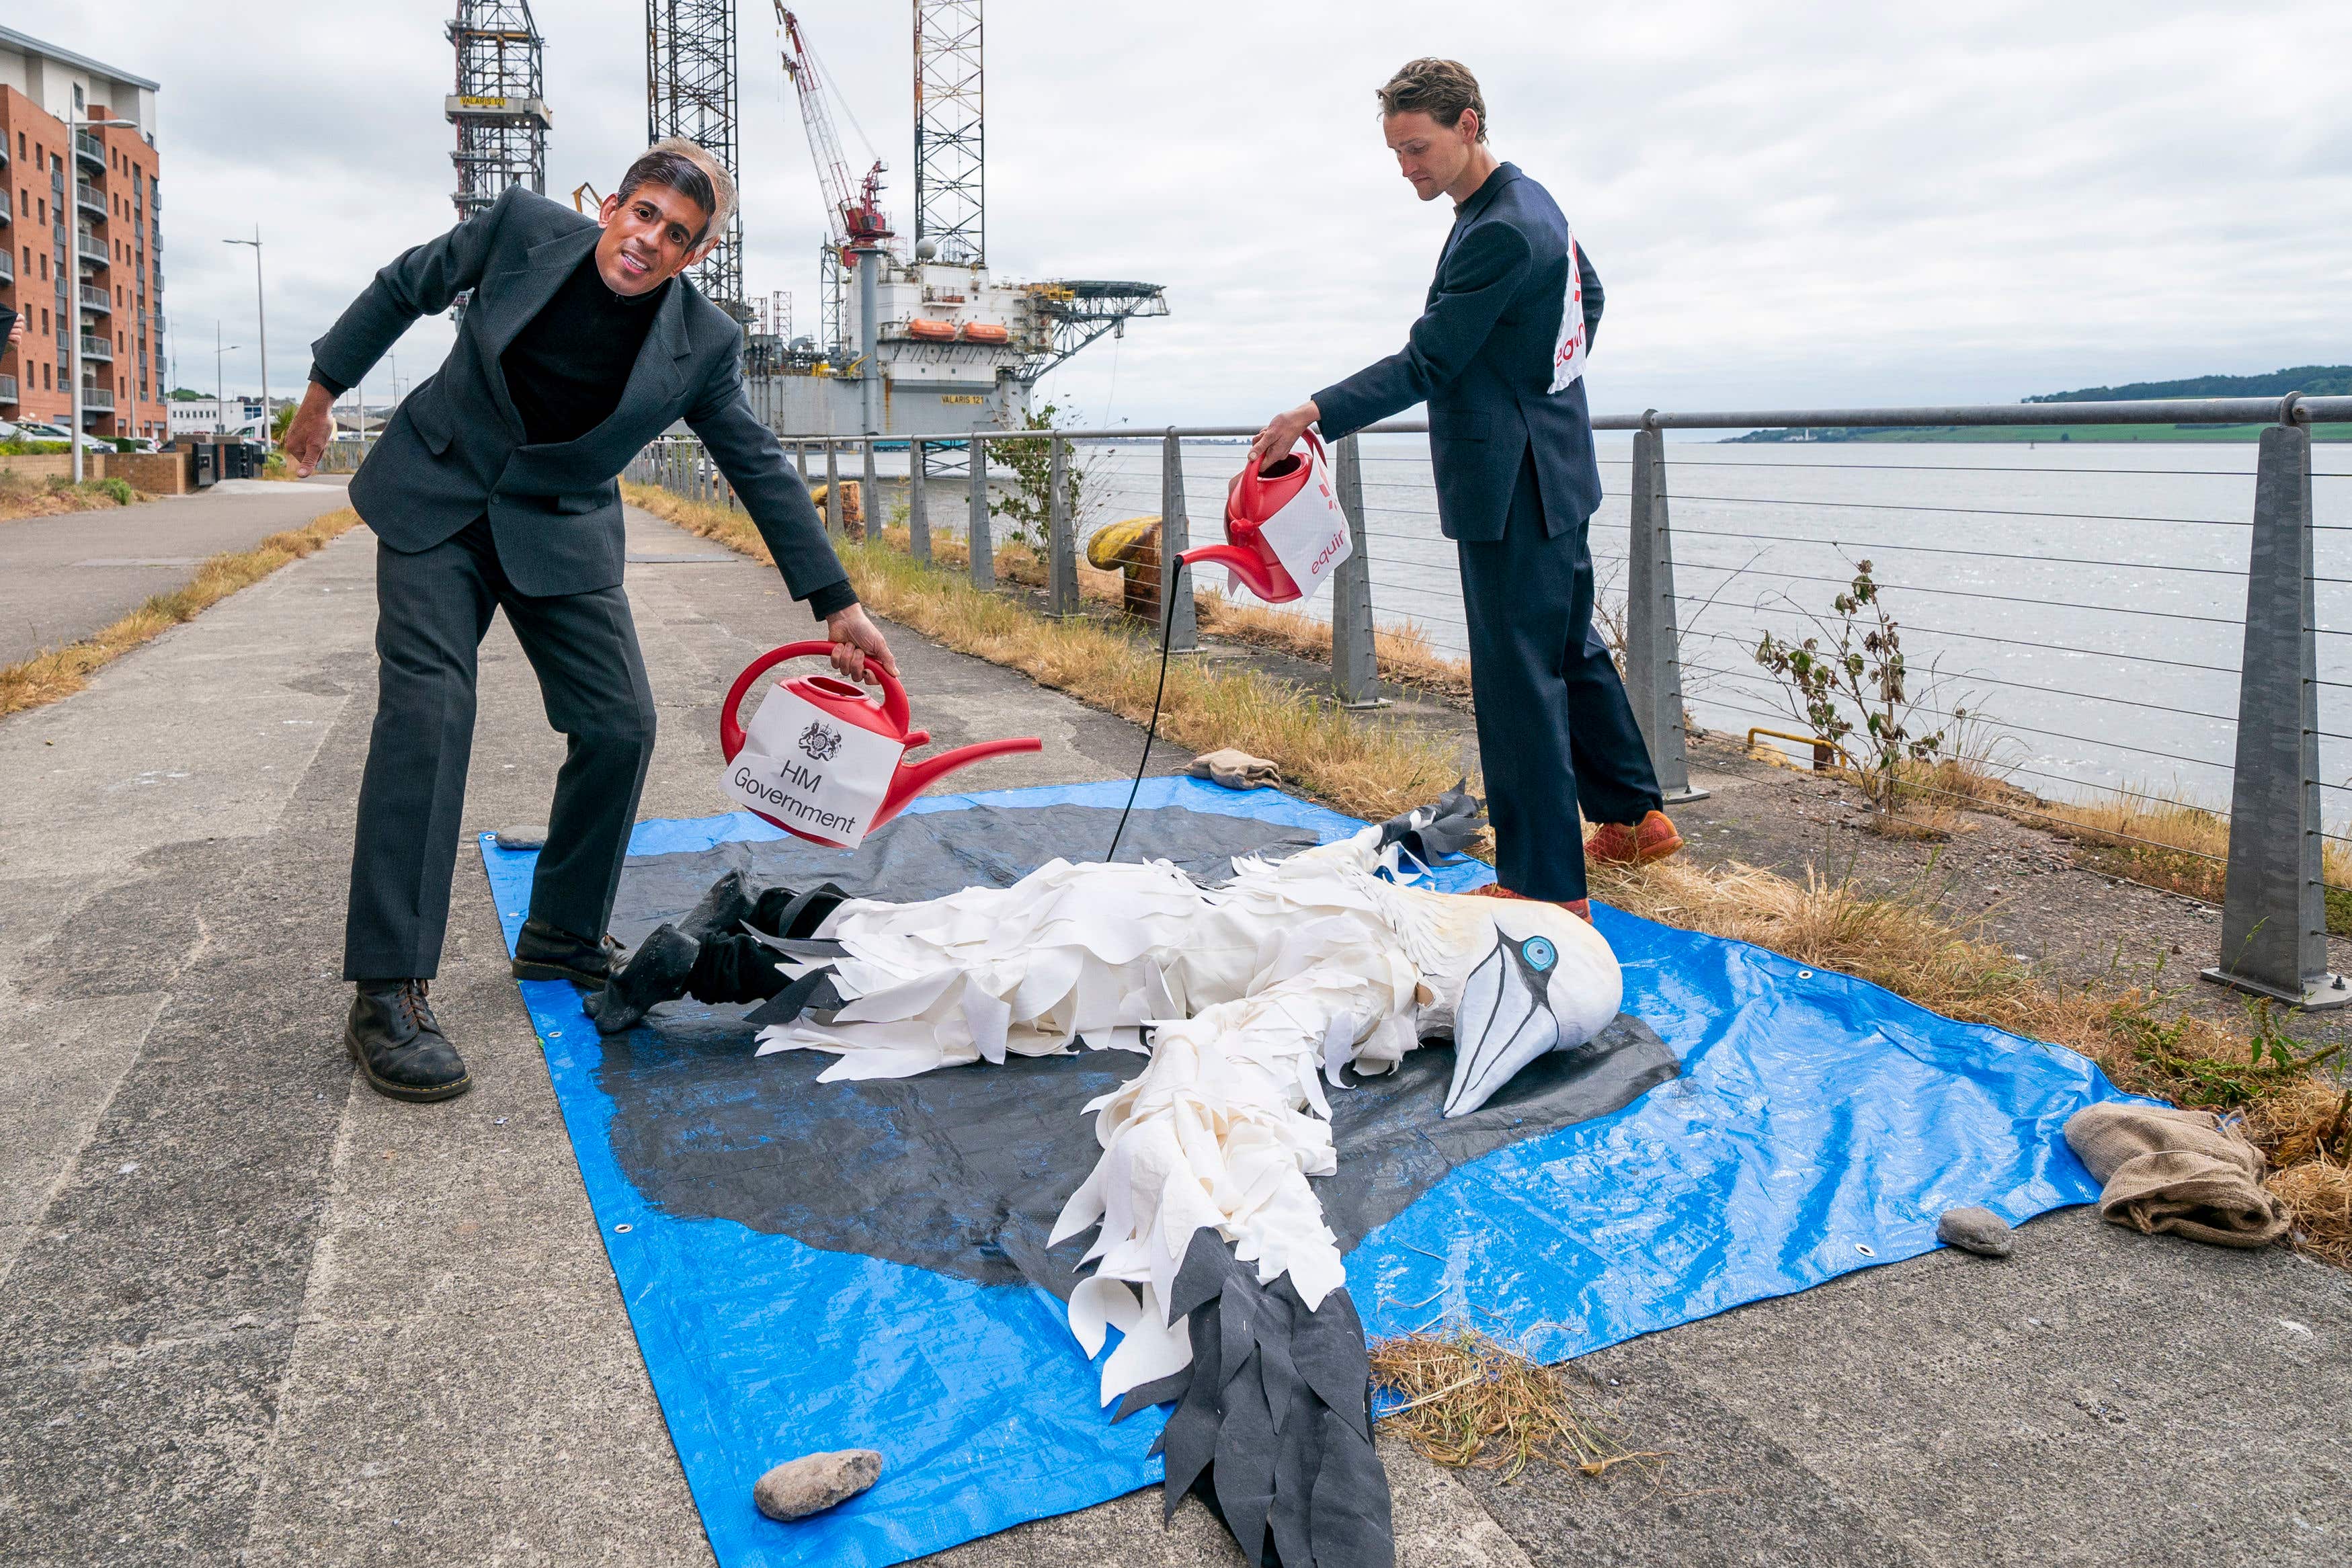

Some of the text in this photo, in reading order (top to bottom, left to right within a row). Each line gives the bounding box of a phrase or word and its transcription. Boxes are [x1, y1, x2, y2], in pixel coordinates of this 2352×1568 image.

[462, 97, 505, 106] VALARIS 121
[942, 395, 983, 404] VALARIS 121
[780, 759, 822, 793] HM
[734, 767, 856, 833] Government
